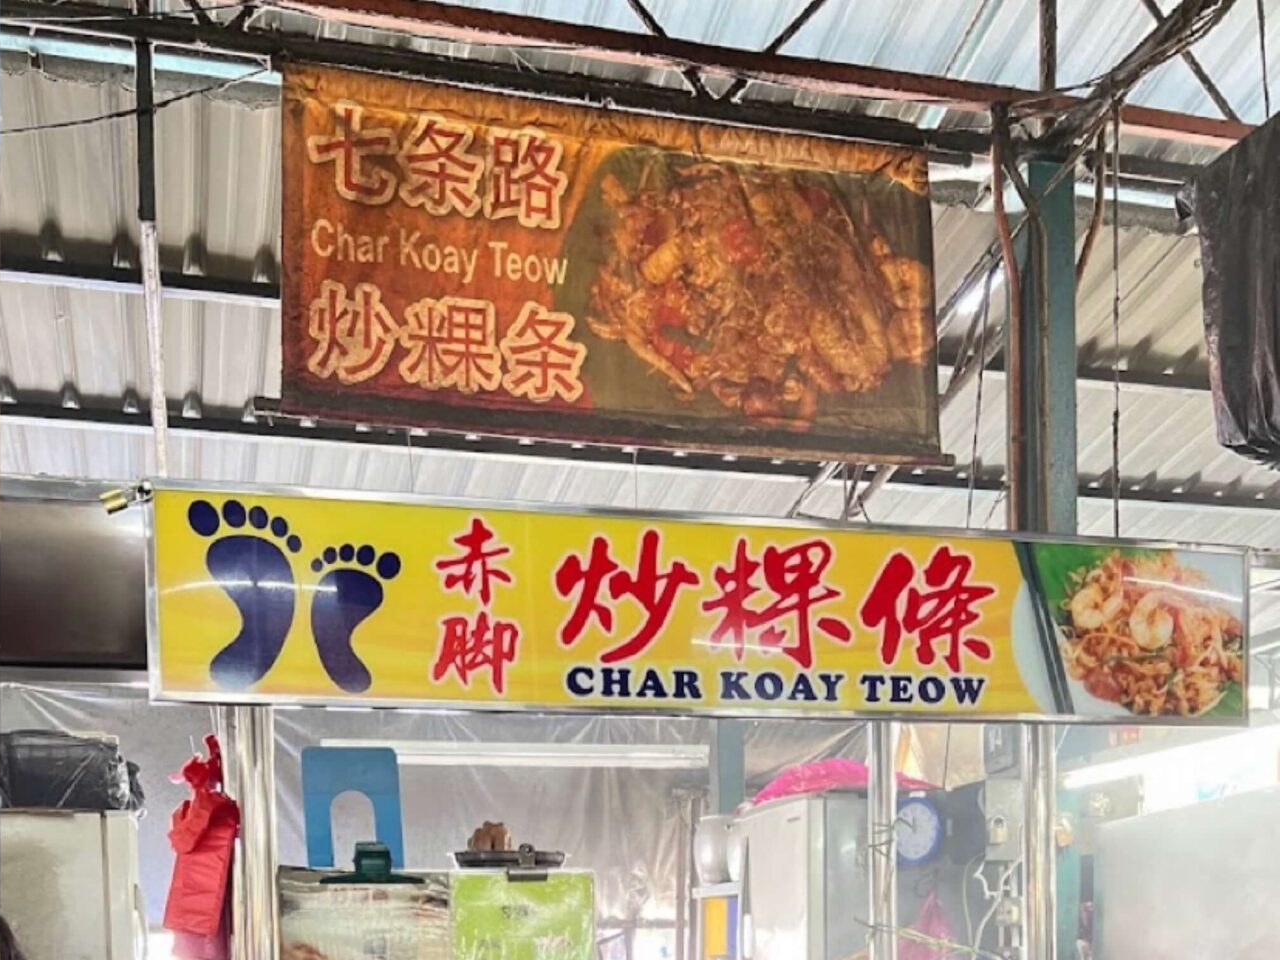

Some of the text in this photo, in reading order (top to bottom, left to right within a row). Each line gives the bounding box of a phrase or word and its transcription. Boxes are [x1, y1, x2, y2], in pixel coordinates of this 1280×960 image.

[311, 101, 564, 227] 七条路
[311, 218, 568, 286] Char Koay Teow
[310, 281, 585, 401] 炒粿条
[432, 517, 519, 694] 赤脚
[554, 529, 996, 673] 炒粿條
[566, 667, 987, 705] CHAR KOAY TEOW
